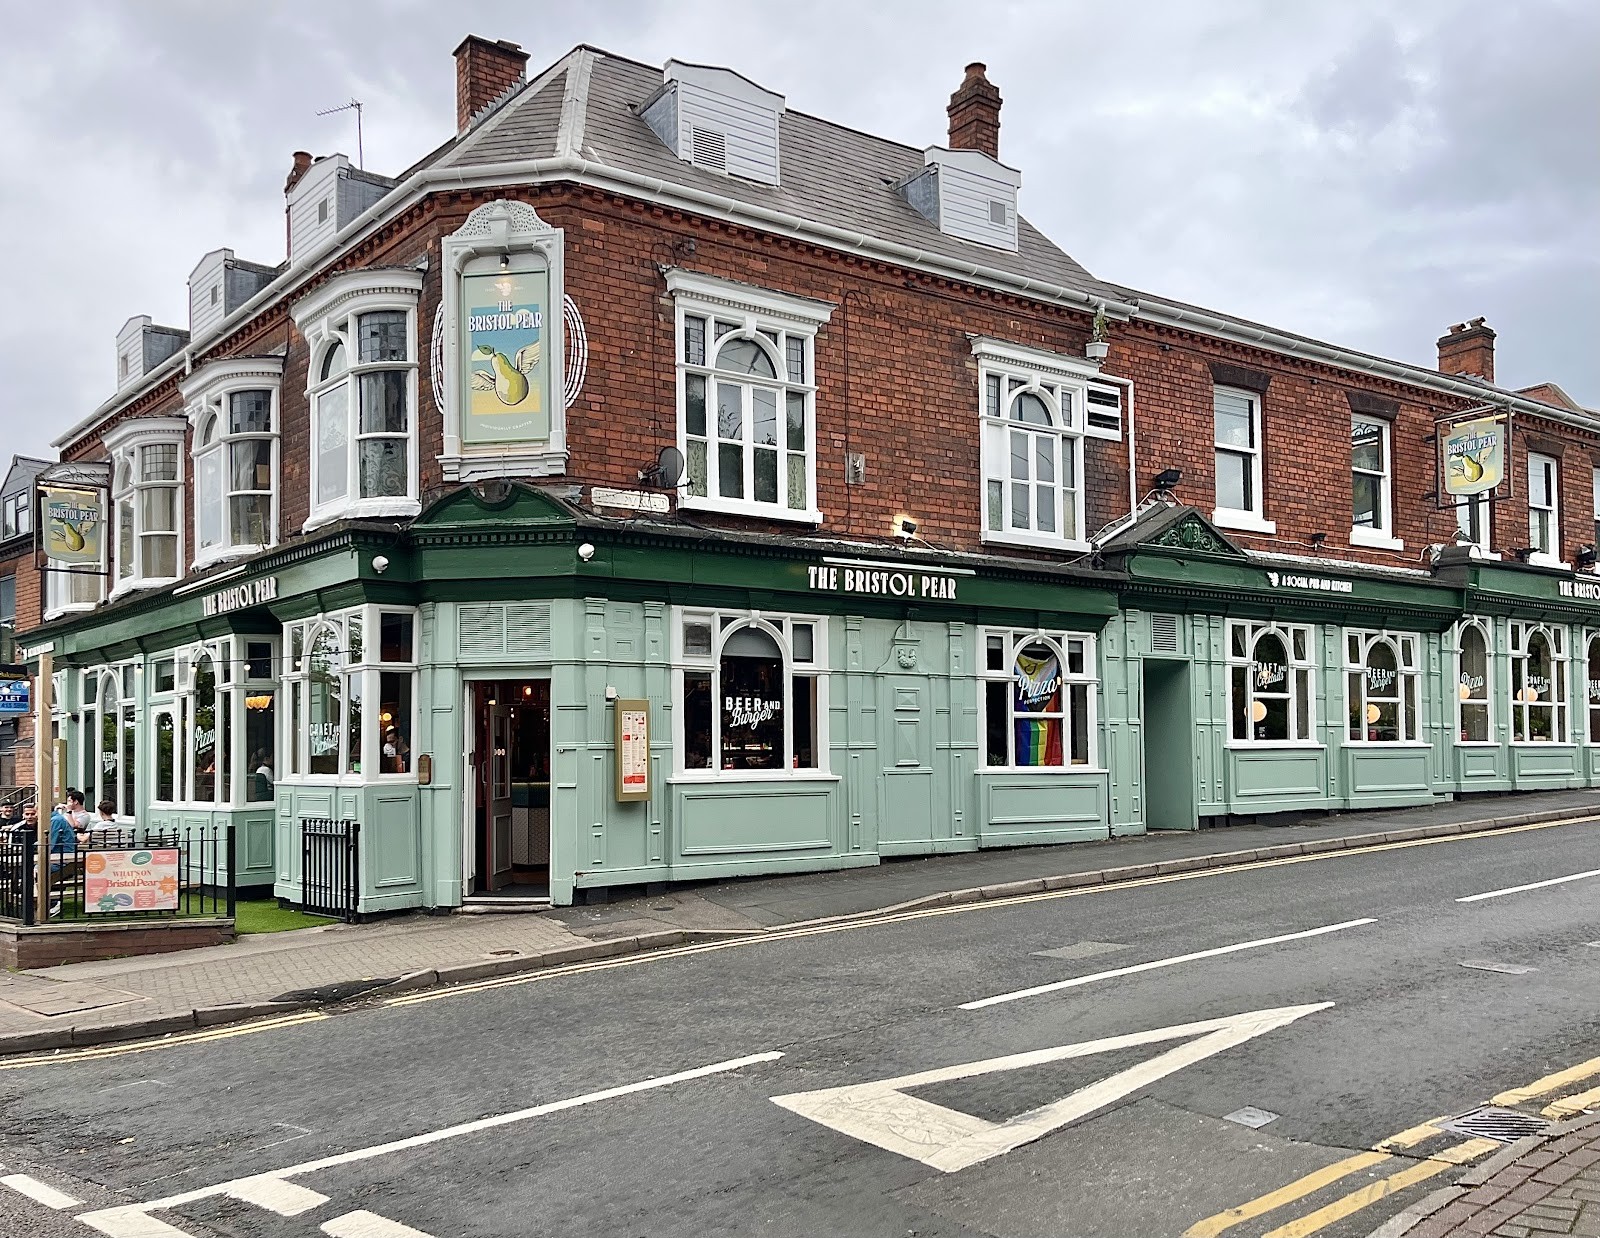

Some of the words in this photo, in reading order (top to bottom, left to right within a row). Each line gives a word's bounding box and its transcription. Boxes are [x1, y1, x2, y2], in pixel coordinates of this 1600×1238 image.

[498, 300, 513, 312] THE
[468, 313, 512, 331] BRISTOL
[515, 312, 542, 329] PEAR
[1467, 432, 1477, 440] THE
[1447, 439, 1477, 455] BRISTOL
[1479, 436, 1497, 449] PEAR
[48, 507, 78, 520] BRISTOL
[80, 510, 98, 522] PEAR
[808, 566, 837, 590] THE
[844, 569, 915, 597] BRISTOL
[921, 575, 956, 599] PEAR
[1281, 575, 1287, 586] A
[1287, 575, 1308, 588] SOCIAL
[1309, 577, 1320, 589] PUB
[1320, 579, 1330, 590] AND
[1331, 580, 1352, 593] KITCHEN
[1559, 580, 1573, 597] THE
[202, 594, 217, 617] THE
[217, 584, 254, 613] BRISTOL
[255, 576, 277, 603] PEAR
[1252, 662, 1278, 673] CRAFT
[1367, 667, 1386, 679] BEER
[1018, 675, 1058, 700] Pizza
[1370, 677, 1392, 692] Burger
[725, 696, 762, 711] BEER
[763, 700, 780, 710] AND
[730, 706, 774, 730] Burger
[309, 722, 333, 736] CRAFT
[195, 725, 215, 751] Pizza
[106, 879, 135, 888] Bristol
[136, 878, 158, 887] Pear
